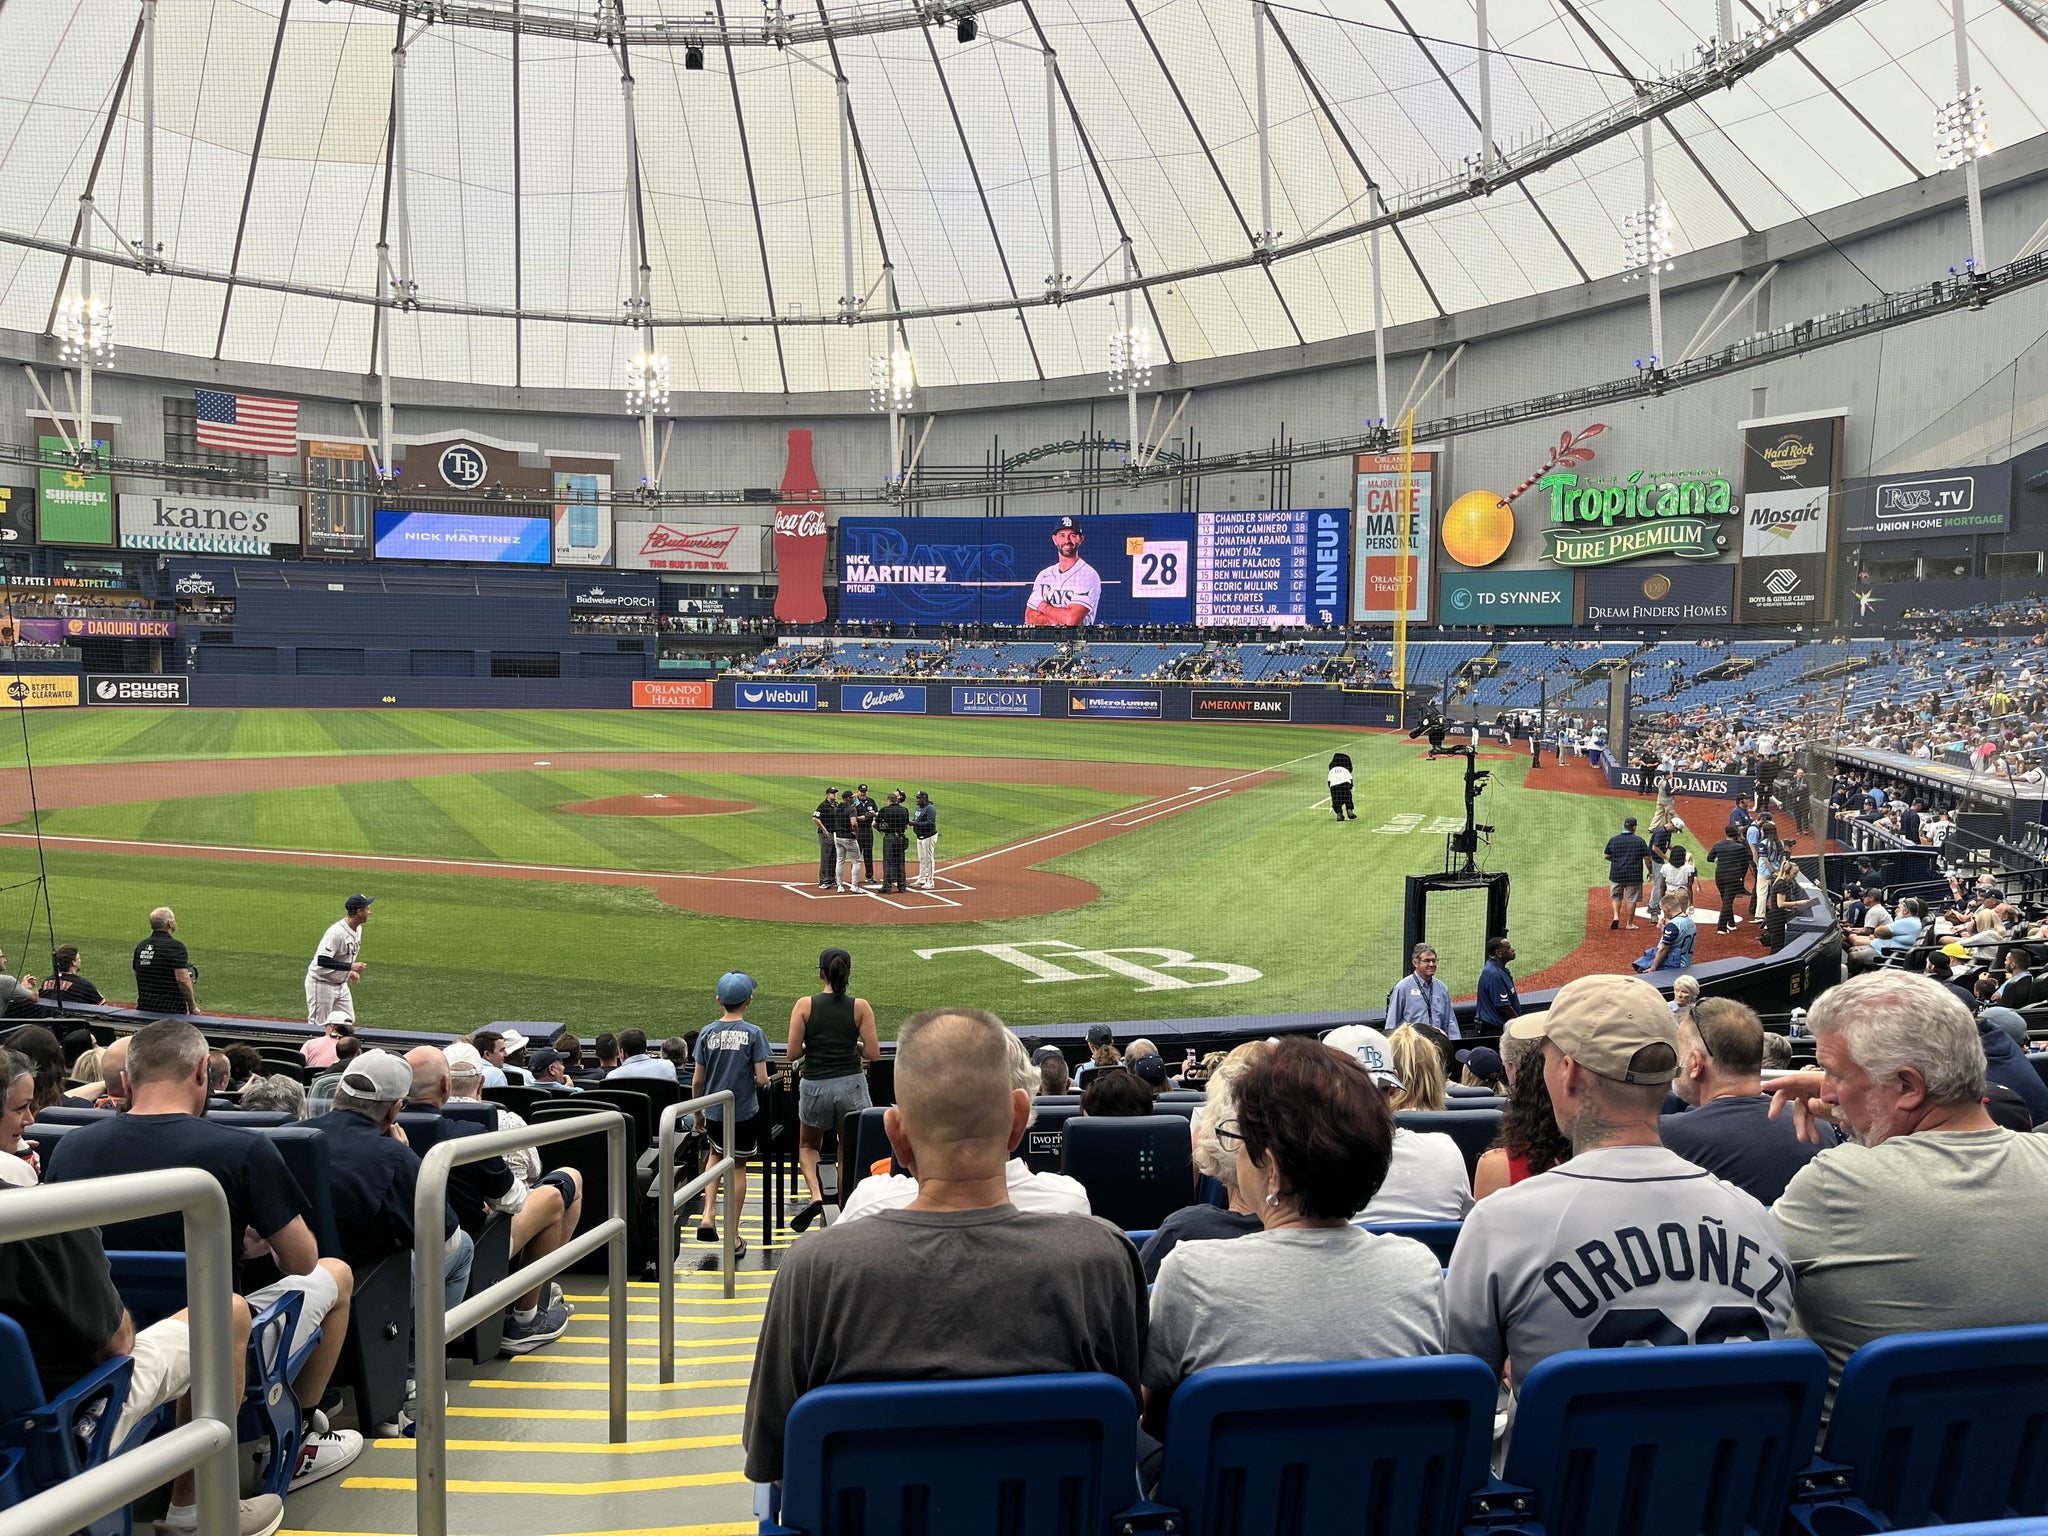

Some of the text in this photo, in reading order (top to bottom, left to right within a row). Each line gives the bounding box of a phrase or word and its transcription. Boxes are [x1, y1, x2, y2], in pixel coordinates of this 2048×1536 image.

[1764, 443, 1814, 459] Hard Rock
[1375, 456, 1415, 464] ORLANO
[448, 453, 480, 481] TB
[1584, 467, 1723, 484] THE ORIGINAL
[1368, 479, 1420, 489] MAJOR LEAUE
[54, 499, 97, 507] RENTALS
[1367, 489, 1420, 514] CARE
[1539, 473, 1731, 527] Tropicana
[153, 498, 269, 533] kane's
[1202, 512, 1305, 524] 14 CHANDLER SIMPSON LF
[1750, 503, 1821, 526] Mosaic
[1202, 524, 1305, 534] 13 JUNIOR CAMINERO 3B
[1876, 515, 2004, 532] UNION HOME MORTGAGE
[165, 531, 259, 542] FURNITURE
[405, 532, 521, 545] NICK MARTINEZ
[648, 533, 730, 549] Budweiser
[1214, 536, 1256, 546] JONATHAN
[1258, 535, 1291, 545] ARANDA
[1295, 535, 1304, 544] 1B
[1366, 537, 1419, 549] PERSONAL
[1556, 526, 1703, 560] PURE PREMIUM
[1203, 545, 1305, 557] 2 YANDY DÍAZ DH
[649, 560, 729, 570] THIS BUD'S FOR YOU.
[846, 555, 870, 565] NICK
[1214, 558, 1240, 568] RICHIE
[1242, 558, 1281, 568] PALACIOS
[1293, 558, 1304, 567] 2B
[1316, 513, 1340, 606] LINEUP
[846, 565, 947, 583] MARTINEZ
[1141, 553, 1178, 586] 28
[1201, 570, 1304, 579] 15 BEN WILLIAMSON SS
[175, 584, 215, 594] PORCH
[846, 584, 876, 593] PITCHER
[1201, 581, 1304, 591] 31 CEDRIC MULLINS CF
[576, 595, 655, 607] Budweiser PORCH
[1200, 593, 1300, 603] 40 NICK FORTES C
[1477, 591, 1561, 604] TD SYNNEX
[1200, 604, 1302, 614] 25 VICTOR MESA JR. RF
[1588, 604, 1727, 618] DREAM FINDERS HOMES
[1213, 617, 1230, 625] NICK
[1232, 617, 1270, 625] MARTINEZ
[1295, 617, 1300, 625] P
[1318, 609, 1333, 623] TB
[88, 621, 169, 636] DAIQUIRI DECK
[32, 691, 73, 699] CLEARWATER
[645, 683, 702, 695] ORLANDO
[652, 695, 695, 705] HEALTH
[766, 690, 808, 703] Webull
[861, 688, 905, 710] Culver's
[1089, 699, 1158, 707] MicroLumen
[1200, 700, 1282, 711] AMERANT BANK
[1686, 778, 1728, 793] JAMES
[912, 940, 1264, 993] TB
[1357, 1044, 1384, 1069] TB
[1033, 1135, 1051, 1144] two
[1543, 1215, 1785, 1319] ORDOÑEZ
